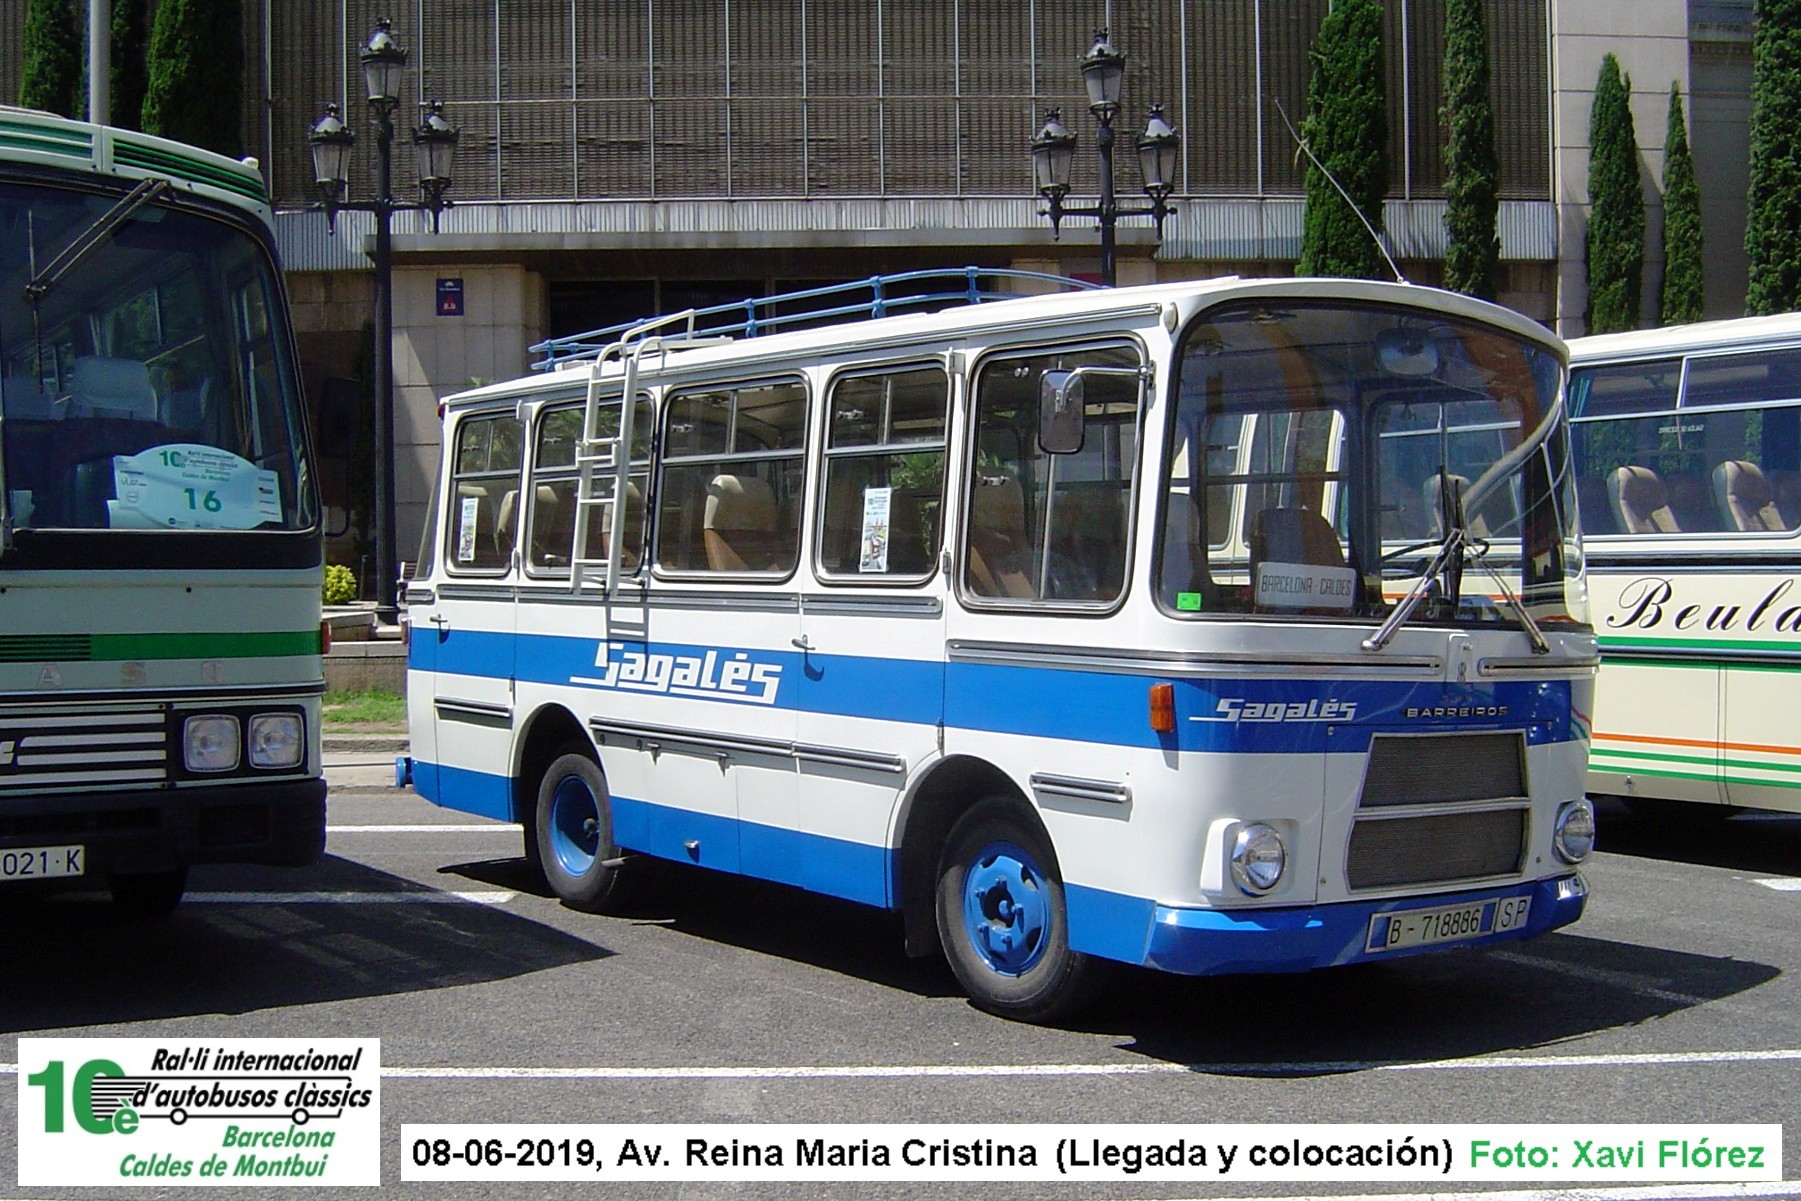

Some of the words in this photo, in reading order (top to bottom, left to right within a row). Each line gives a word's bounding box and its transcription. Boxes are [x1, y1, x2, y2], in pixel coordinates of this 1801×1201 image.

[183, 487, 222, 513] 16
[1261, 574, 1313, 594] BARCELONA
[1319, 576, 1351, 596] CALDES
[569, 641, 783, 705] Sagalés
[1188, 698, 1358, 722] Sagalés
[1405, 706, 1510, 719] BARREIROS
